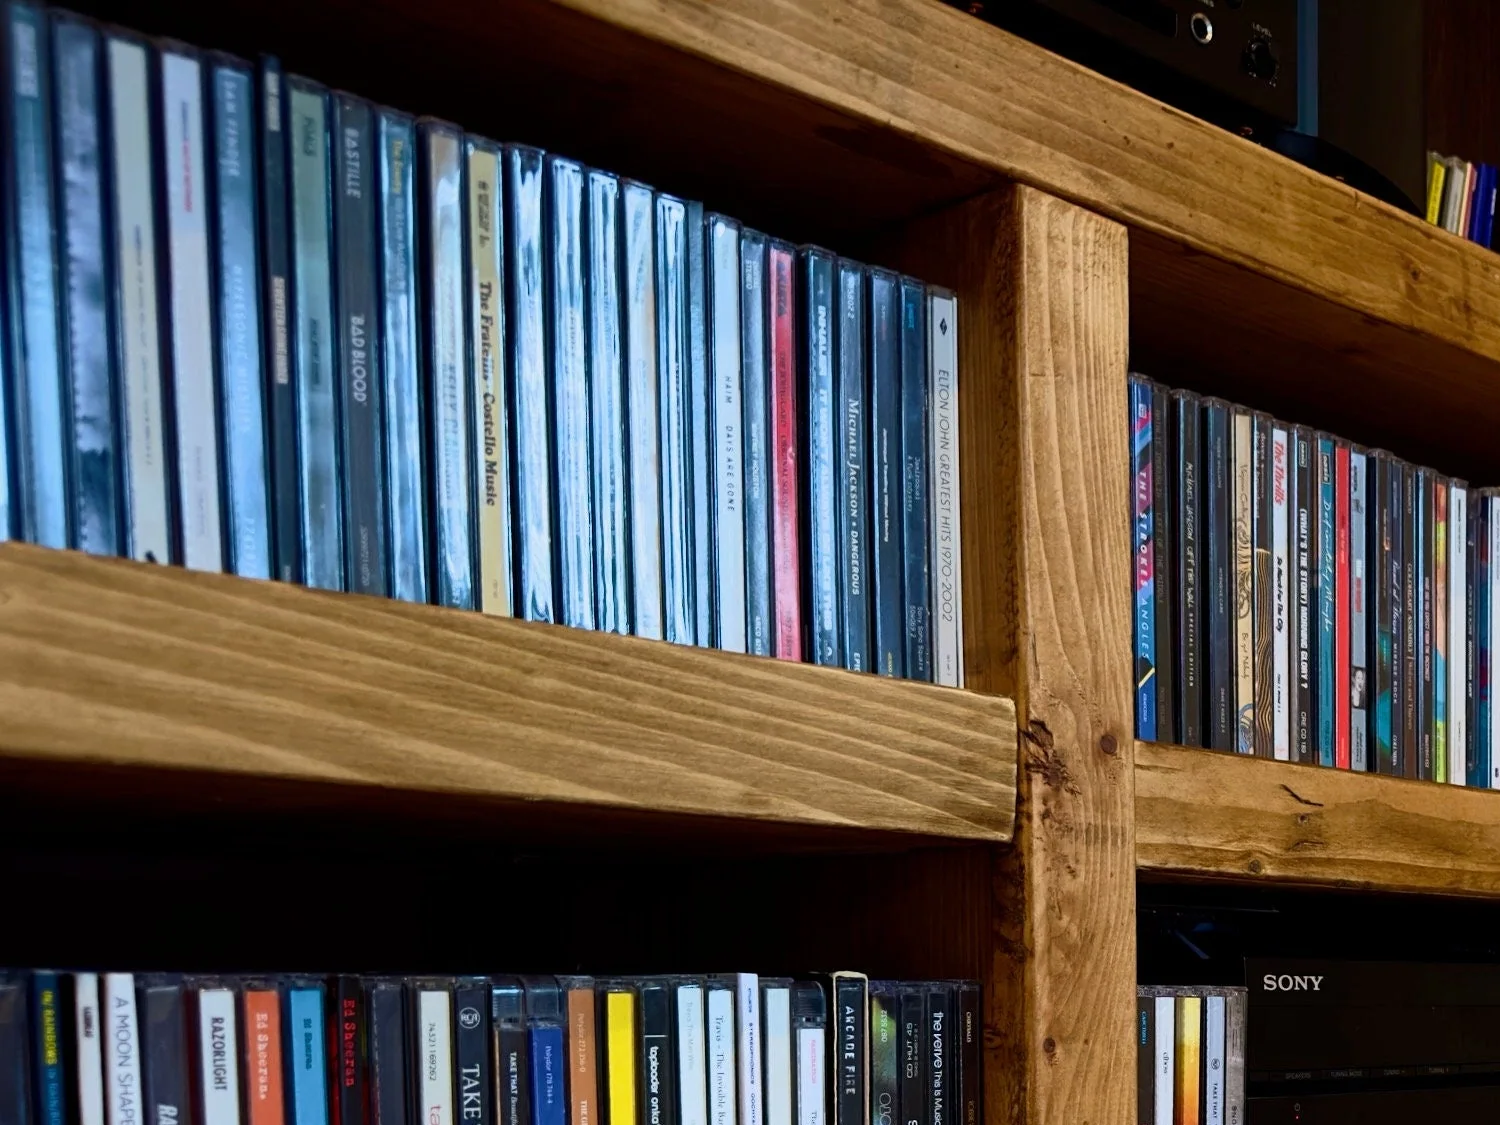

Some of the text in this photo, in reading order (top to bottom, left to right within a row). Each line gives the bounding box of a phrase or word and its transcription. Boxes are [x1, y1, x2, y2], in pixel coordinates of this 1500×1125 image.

[345, 128, 361, 199] BASTILLE
[818, 305, 828, 376] INHALER
[480, 281, 498, 506] The Costello Music
[725, 375, 735, 512] HAIM DAYS ARE GONE
[1275, 441, 1284, 463] The
[847, 398, 860, 595] MICHAEL JACKSON DANGEROUS
[938, 369, 953, 622] ELTON JOHN GREATEST HITS 1970-2002
[1186, 461, 1195, 501] MICHAEL
[1275, 465, 1285, 506] Thrills
[1186, 505, 1195, 540] JACKSON
[1299, 508, 1308, 549] (WHAT'S
[1139, 472, 1149, 659] THE STROKES ANGLES
[1187, 546, 1195, 565] OFF
[1300, 551, 1308, 568] THE
[1187, 567, 1195, 585] THE
[1300, 570, 1308, 604] STORY)
[1187, 587, 1195, 609] WALL
[1276, 618, 1284, 633] City
[1263, 975, 1324, 991] SONY
[115, 997, 129, 1008] A
[344, 1000, 355, 1016] Ed
[43, 1009, 57, 1065] RAINBOWS
[256, 1012, 268, 1030] Ed
[715, 1016, 724, 1042] Travis
[844, 1006, 856, 1060] ARCADE
[933, 1011, 944, 1031] the
[116, 1015, 132, 1067] MOON
[211, 1017, 228, 1090] RAZORLIGHT
[304, 1032, 313, 1069] Sheeran
[344, 1022, 357, 1087] Sheeran
[544, 1046, 553, 1071] Polydor
[933, 1034, 943, 1069] verve
[510, 1052, 518, 1072] TAKE
[648, 1046, 660, 1093] toploader
[716, 1052, 725, 1069] The
[462, 1063, 480, 1120] TAKE
[510, 1074, 518, 1094] THAT
[717, 1072, 726, 1107] Invisible
[845, 1065, 856, 1095] FIRE
[934, 1070, 943, 1087] This
[580, 1100, 588, 1116] THE
